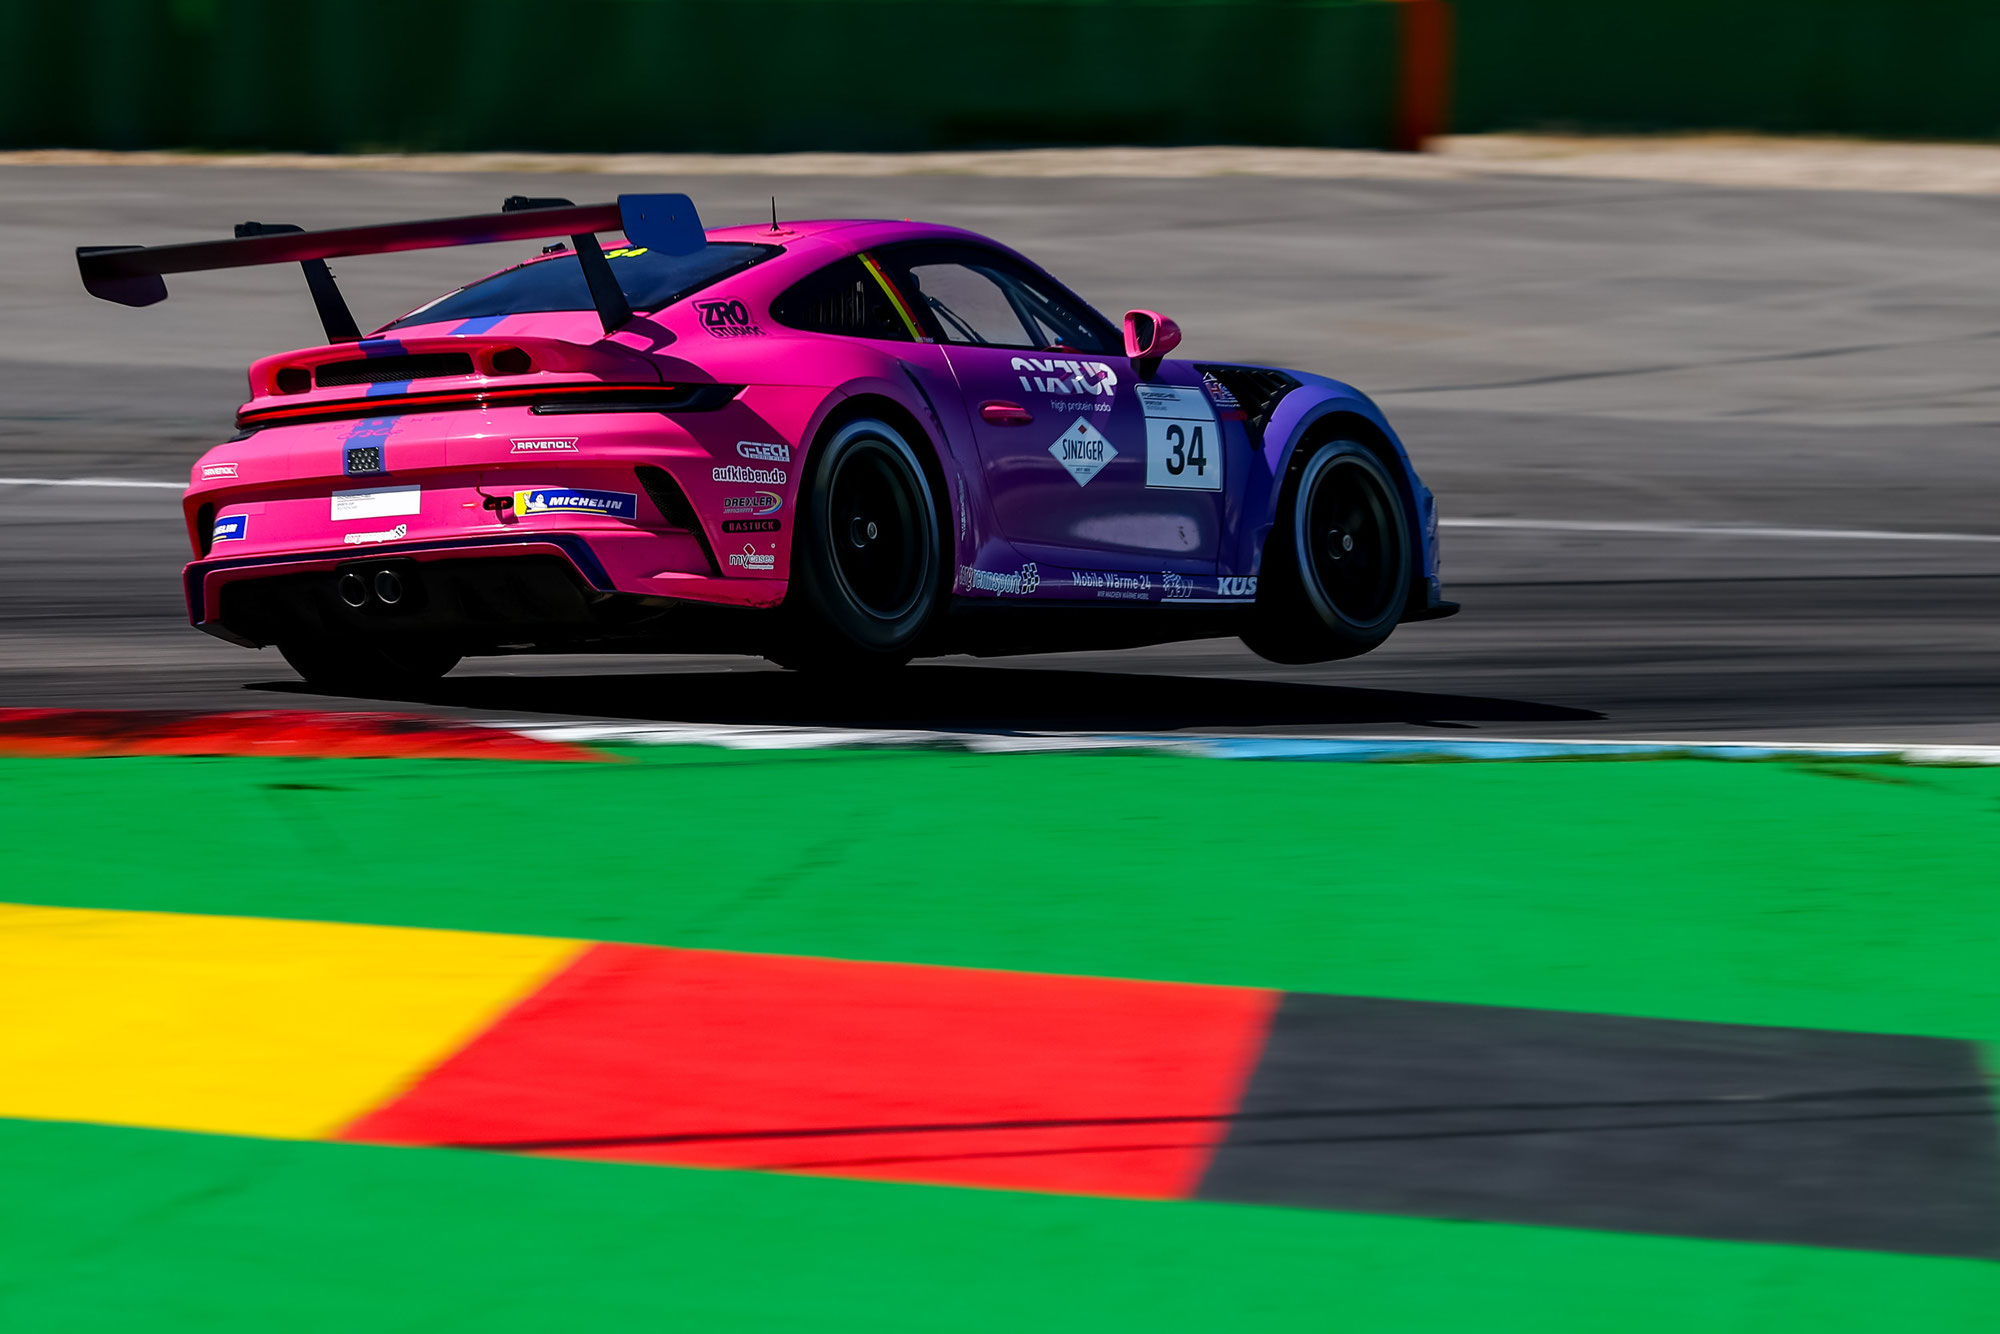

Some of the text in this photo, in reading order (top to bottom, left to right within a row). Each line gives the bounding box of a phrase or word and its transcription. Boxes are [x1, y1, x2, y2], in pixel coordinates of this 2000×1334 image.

[698, 300, 749, 326] ZRO
[1050, 400, 1112, 412] high protein soda
[516, 441, 572, 450] RAVENOL
[1062, 439, 1104, 462] SINZIGER
[1165, 424, 1207, 476] 34
[712, 465, 787, 484] aufkleben.de
[548, 497, 623, 510] MICHELIN
[724, 496, 775, 508] DREXLER
[729, 521, 774, 531] BASTUCK
[729, 554, 775, 569] mycases
[1072, 572, 1151, 590] Mobile Wärme 24
